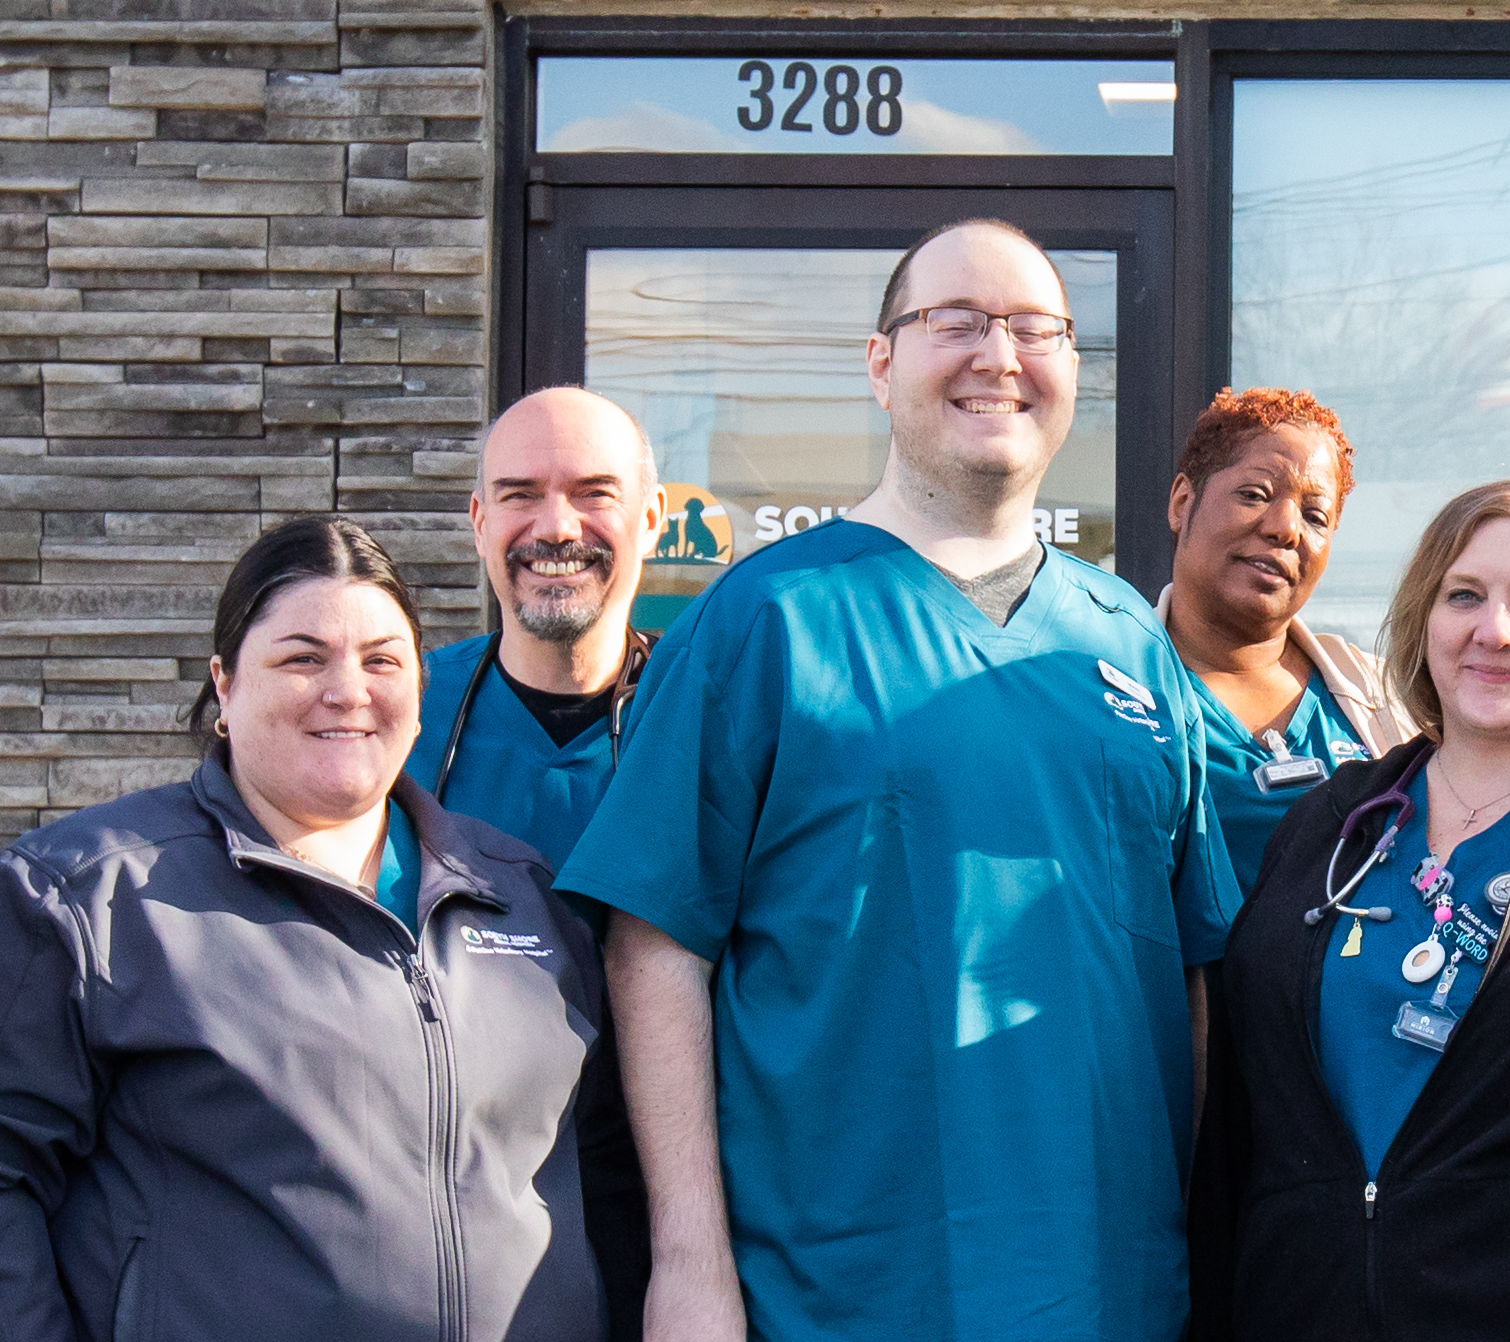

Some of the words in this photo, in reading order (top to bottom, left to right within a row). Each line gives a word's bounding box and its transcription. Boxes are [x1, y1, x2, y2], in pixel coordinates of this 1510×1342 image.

[737, 60, 904, 137] 3288
[1457, 902, 1482, 926] Please
[1443, 921, 1488, 961] Q-WORD
[1475, 932, 1487, 945] the
